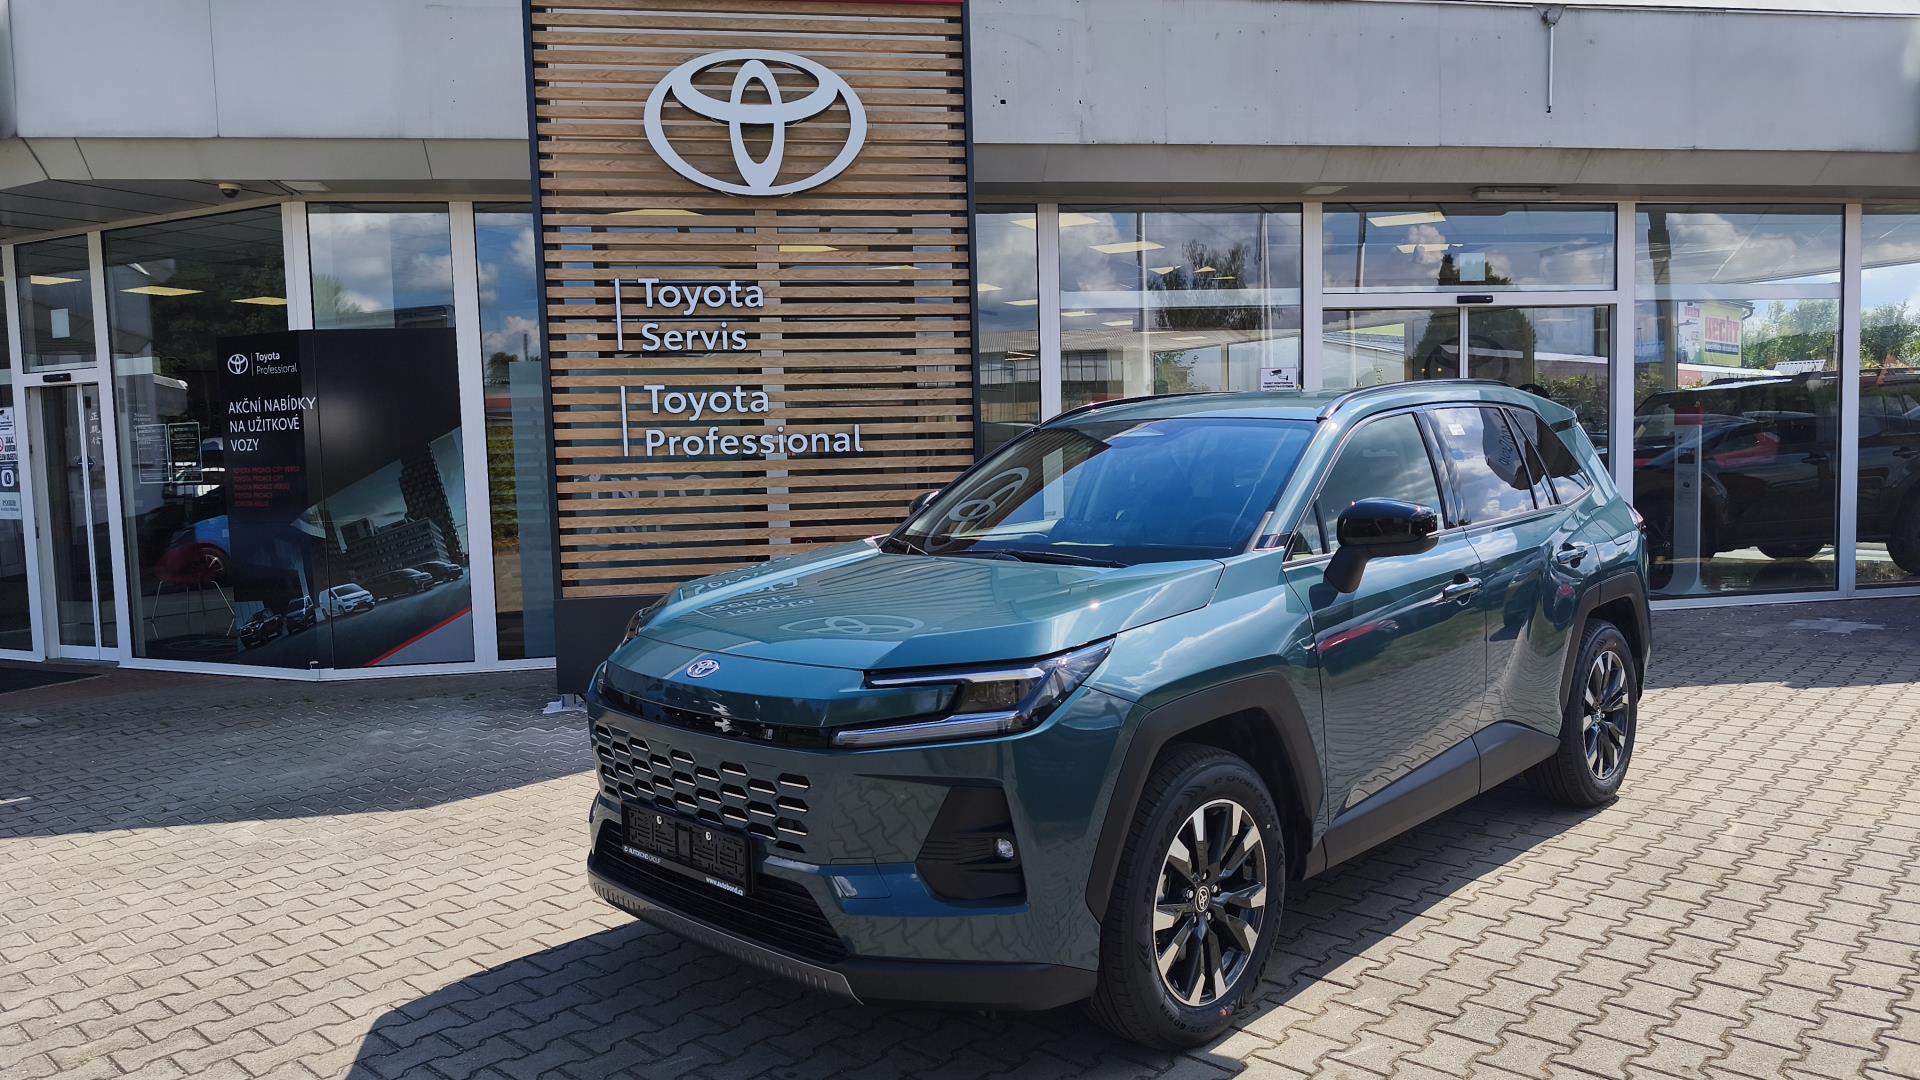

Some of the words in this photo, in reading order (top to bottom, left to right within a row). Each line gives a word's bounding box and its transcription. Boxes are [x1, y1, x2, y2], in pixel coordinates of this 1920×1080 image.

[637, 278, 764, 316] Toyota
[641, 322, 748, 352] Servis
[255, 351, 280, 363] Toyota
[256, 362, 298, 375] Professional
[229, 396, 261, 414] AKČNÍ
[264, 395, 316, 412] NABÍDKY
[643, 385, 770, 421] Toyota
[229, 420, 246, 433] NA
[248, 414, 300, 432] UŽITKOVÉ
[230, 438, 259, 452] VOZY
[645, 424, 864, 457] Professional
